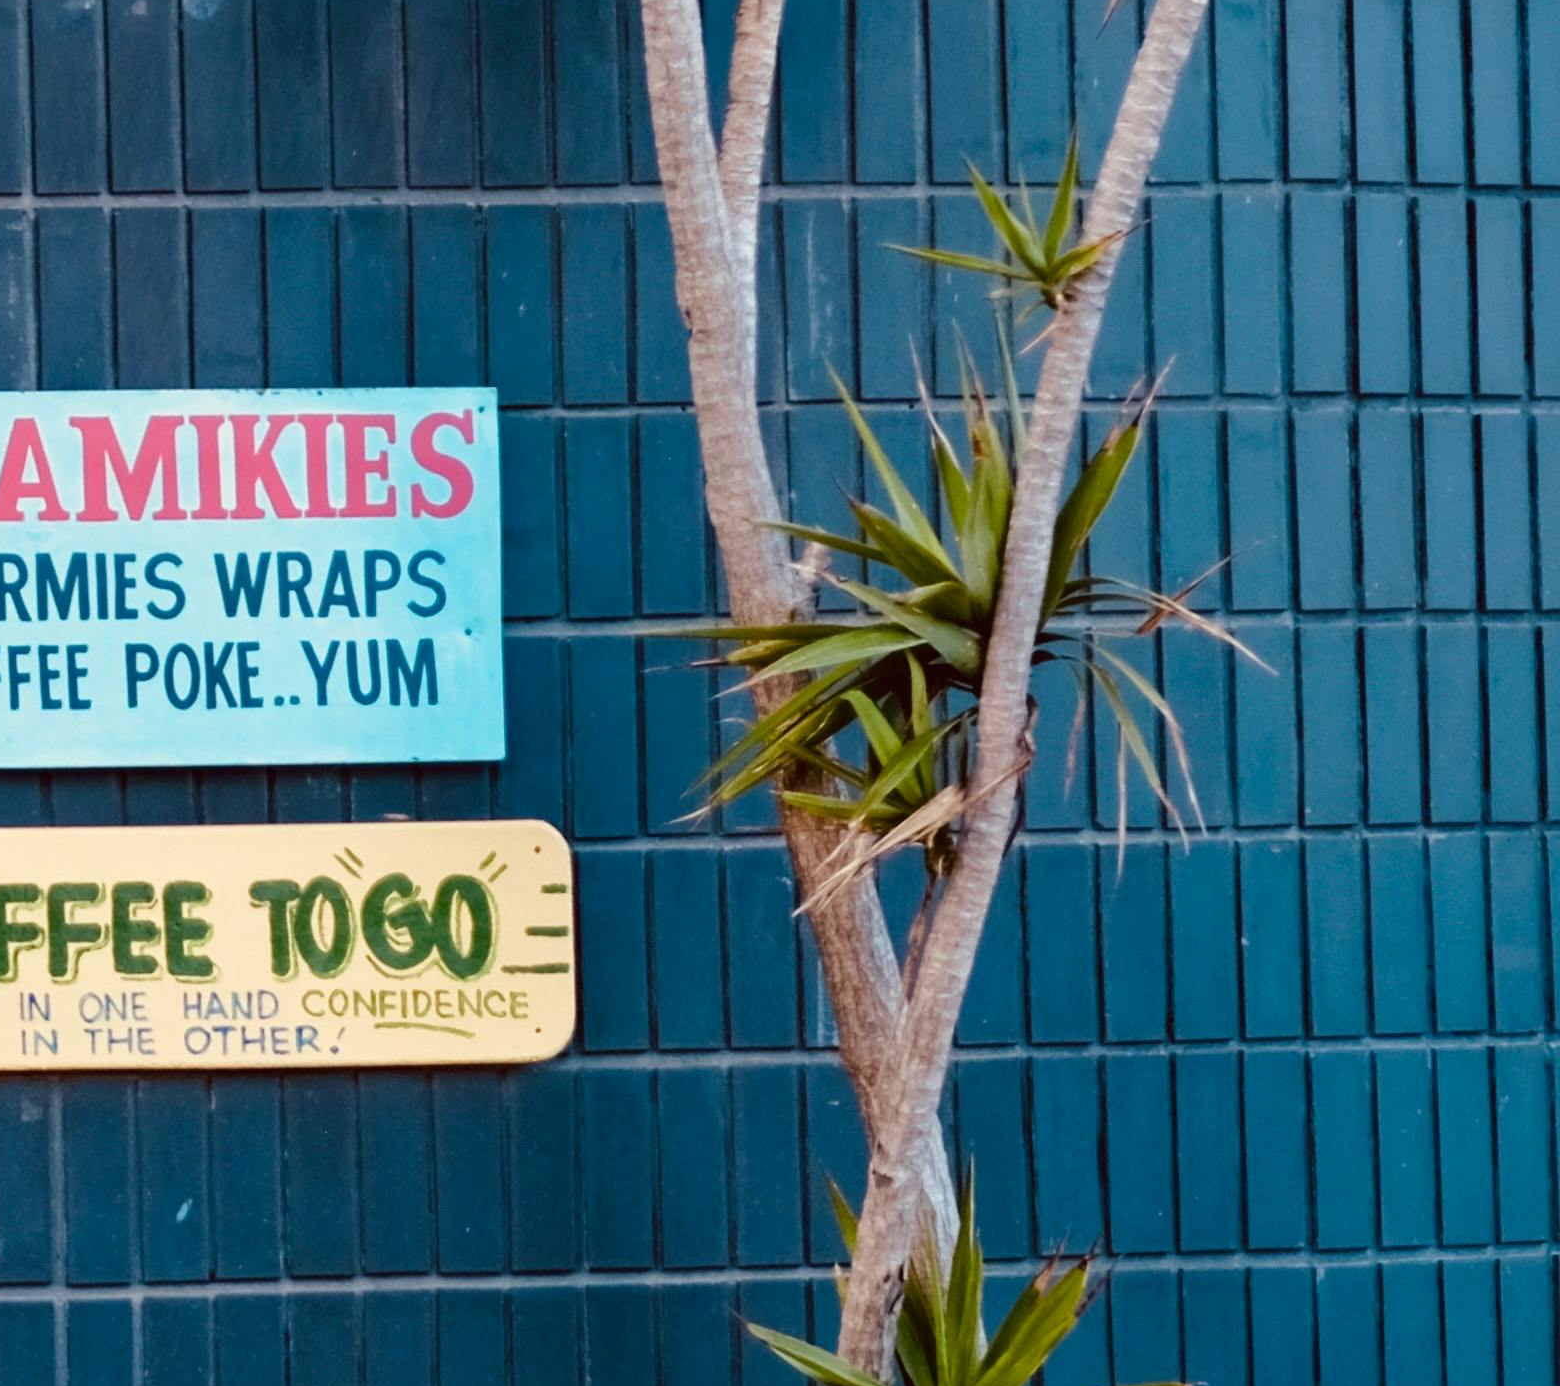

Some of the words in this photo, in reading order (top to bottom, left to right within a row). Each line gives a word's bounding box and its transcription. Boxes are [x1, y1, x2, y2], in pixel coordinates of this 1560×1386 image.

[215, 549, 448, 618] WRAPS
[19, 990, 52, 1021] IN
[78, 990, 149, 1021] ONE
[184, 989, 279, 1021] HAND
[302, 986, 530, 1021] CONFIDENCE
[21, 1028, 58, 1056] IN
[84, 1027, 157, 1055] THE
[184, 1023, 347, 1058] OTHER!
